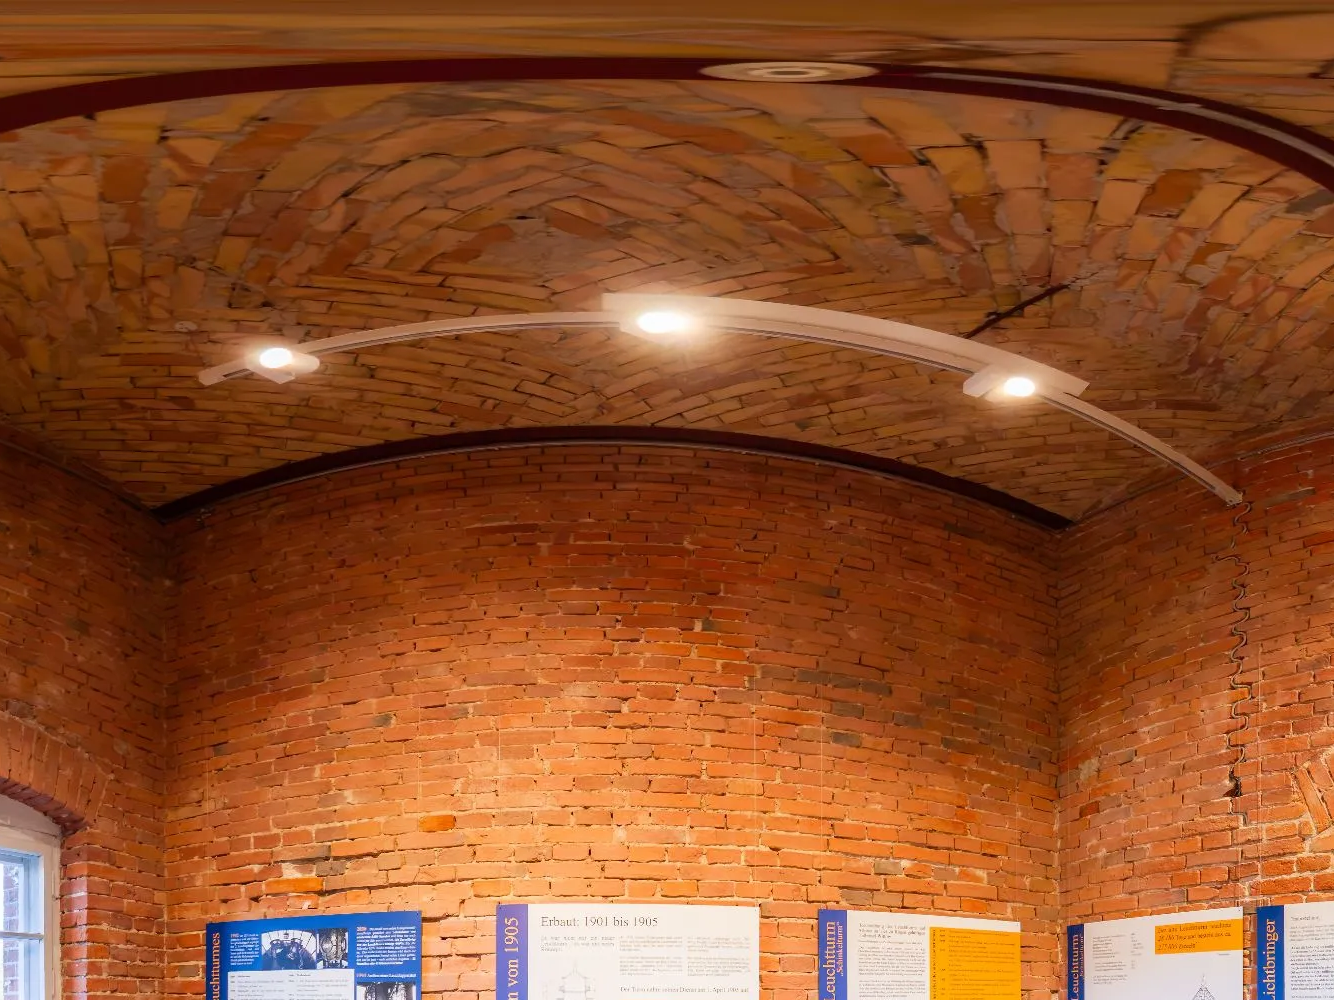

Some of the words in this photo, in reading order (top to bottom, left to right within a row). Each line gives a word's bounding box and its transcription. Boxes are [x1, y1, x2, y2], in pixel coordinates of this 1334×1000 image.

[504, 917, 519, 952] 1905
[541, 916, 579, 927] Erbaut:
[584, 916, 608, 927] 1901
[613, 916, 629, 927] bis
[634, 916, 658, 927] 1905
[508, 958, 518, 987] von
[1071, 934, 1079, 1000] Leuchtturm
